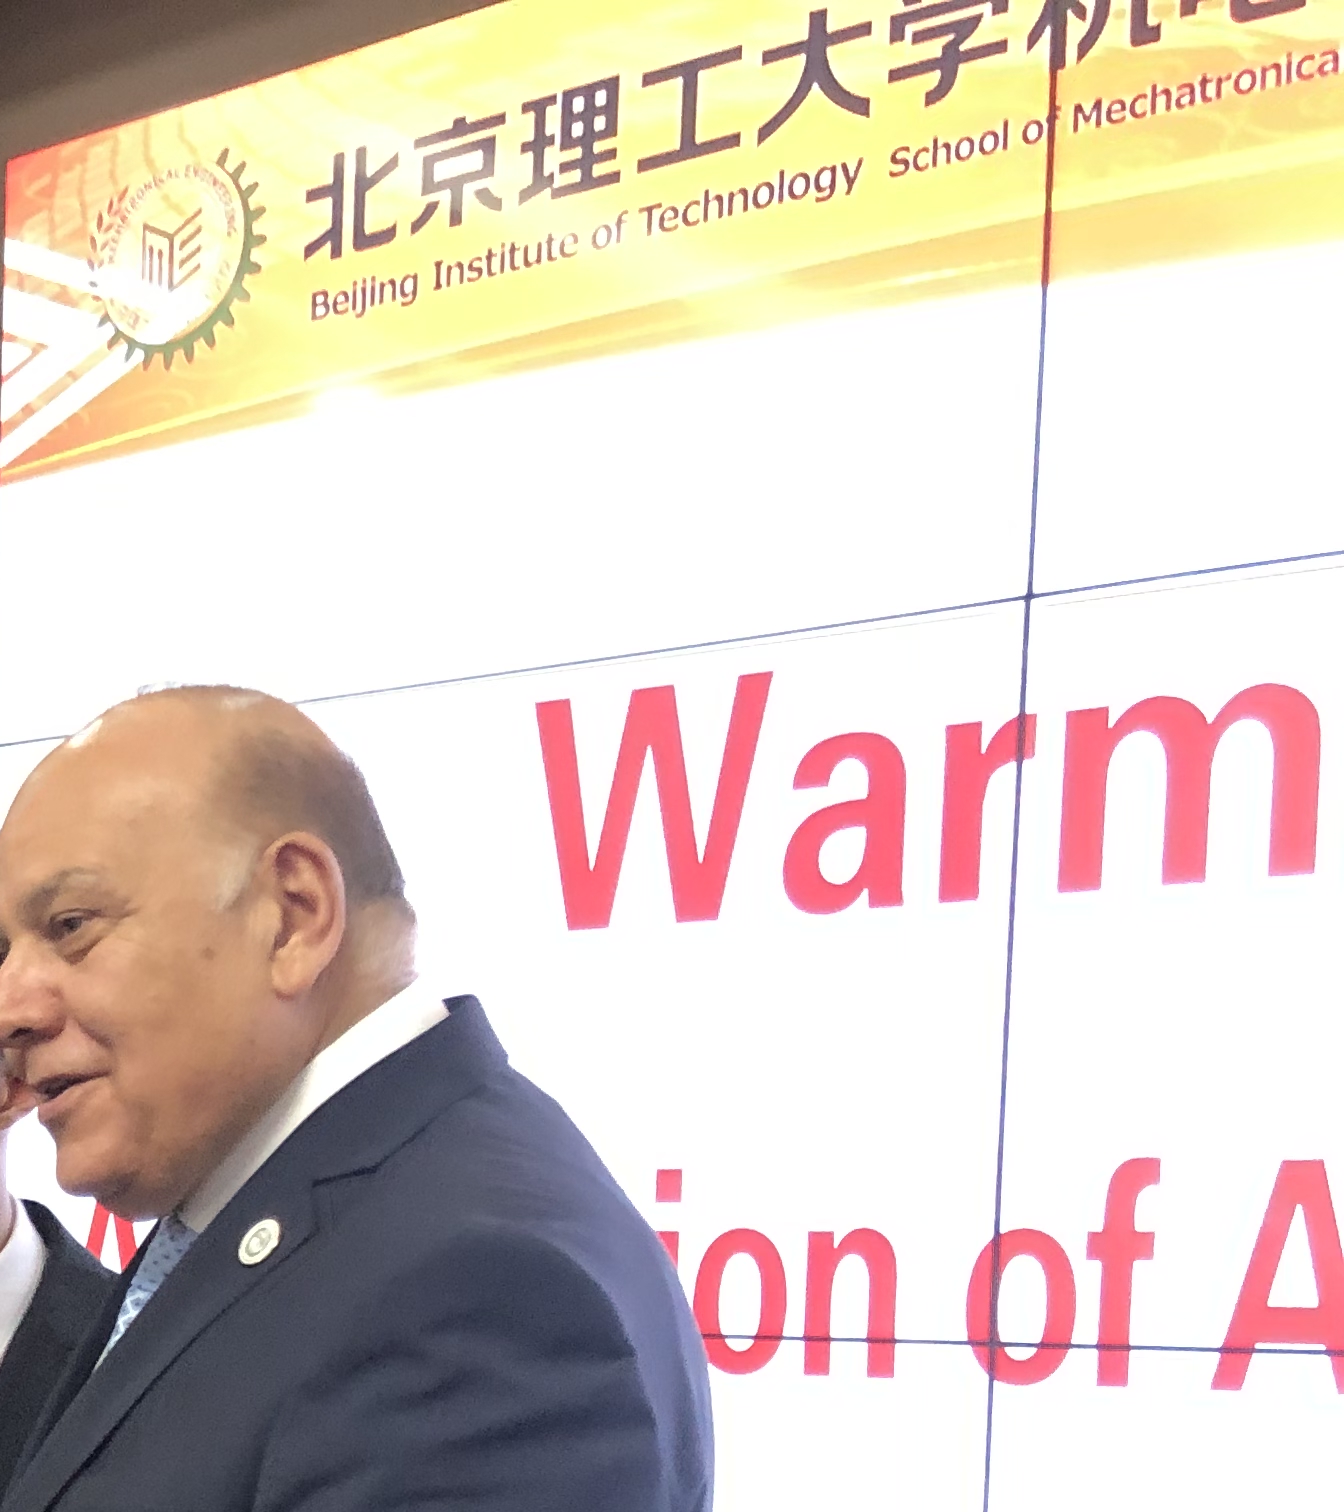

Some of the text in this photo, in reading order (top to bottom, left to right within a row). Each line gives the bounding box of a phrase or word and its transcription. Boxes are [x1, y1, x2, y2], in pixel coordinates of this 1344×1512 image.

[303, 0, 1308, 262] 北京理工大学机
[311, 48, 1340, 321] Beijing Institute of Technology School of Mechatronica
[534, 670, 1321, 932] Warm
[966, 1157, 1161, 1387] of
